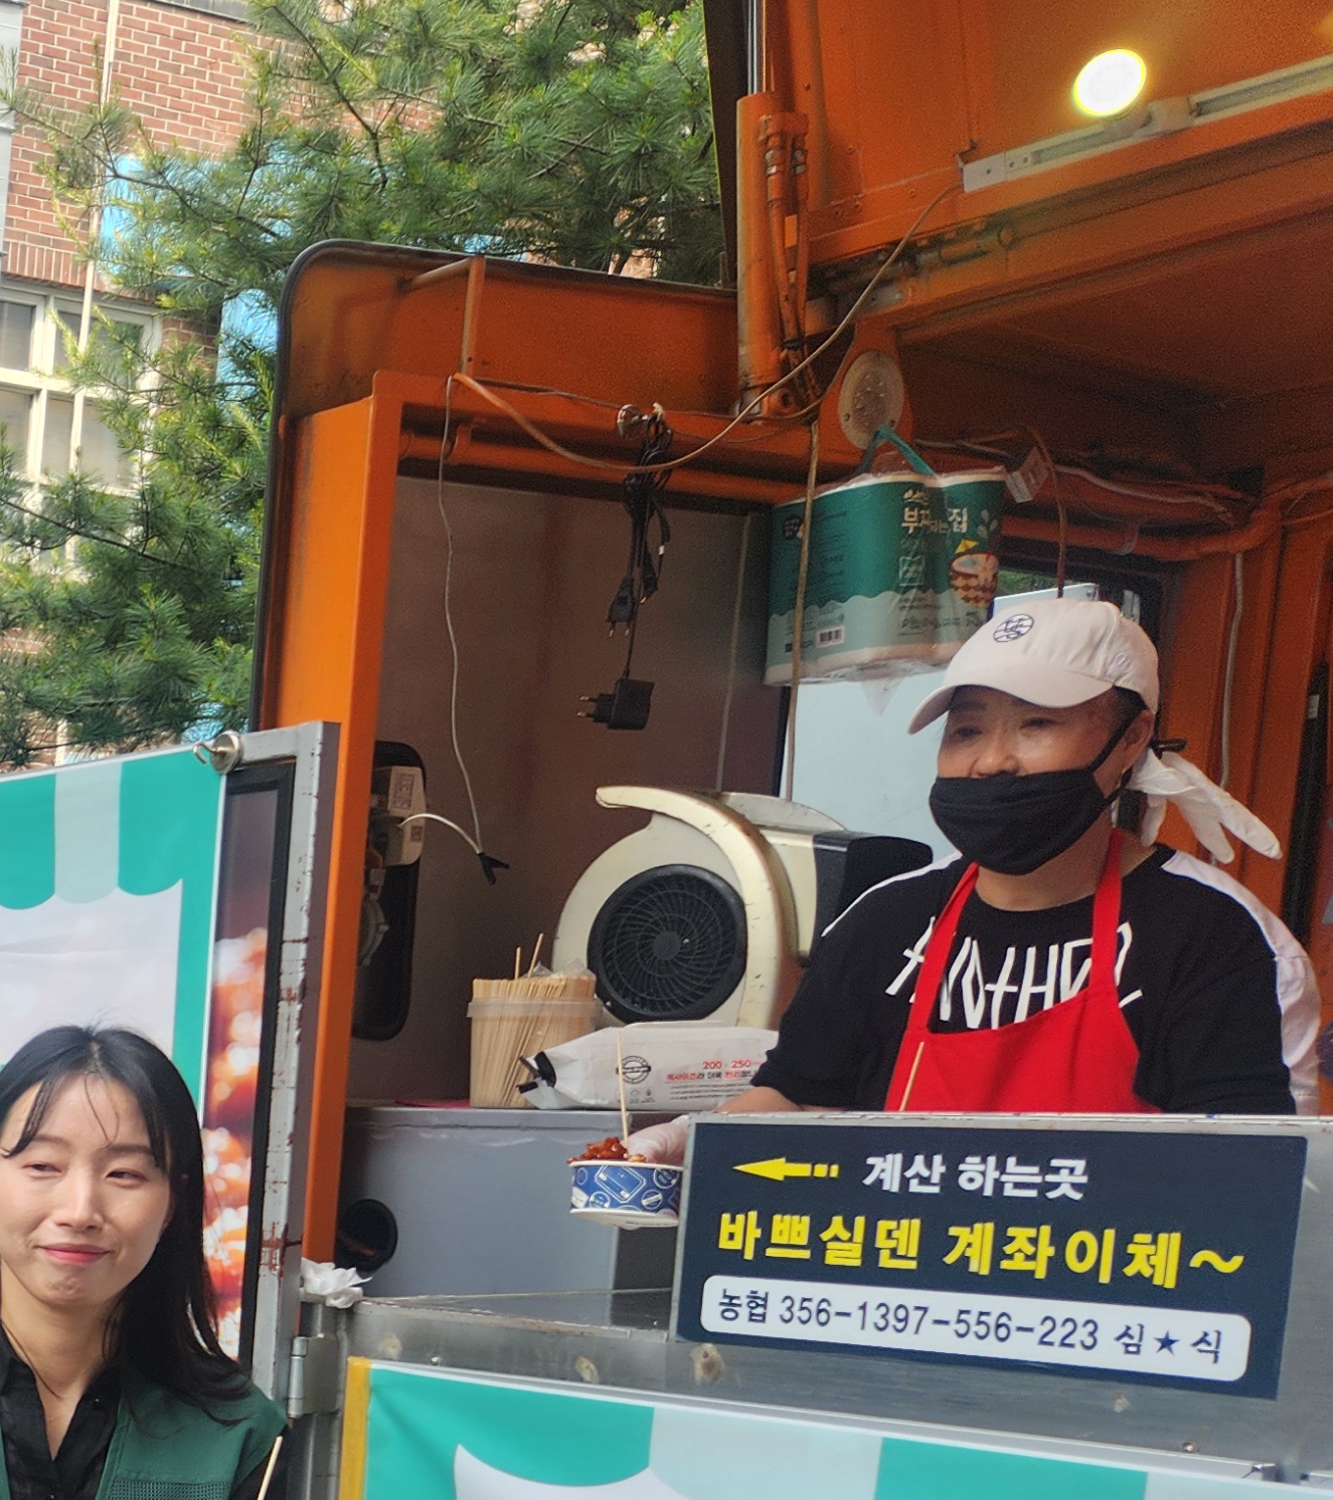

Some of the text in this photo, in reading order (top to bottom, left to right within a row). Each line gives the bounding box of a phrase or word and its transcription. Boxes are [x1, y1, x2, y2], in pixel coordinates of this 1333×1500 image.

[862, 1152, 1089, 1200] 계산 하는곳
[718, 1209, 921, 1271] 바쁘실덴
[719, 1287, 770, 1324] 농협
[779, 1294, 1099, 1351] 356-1397-556-223
